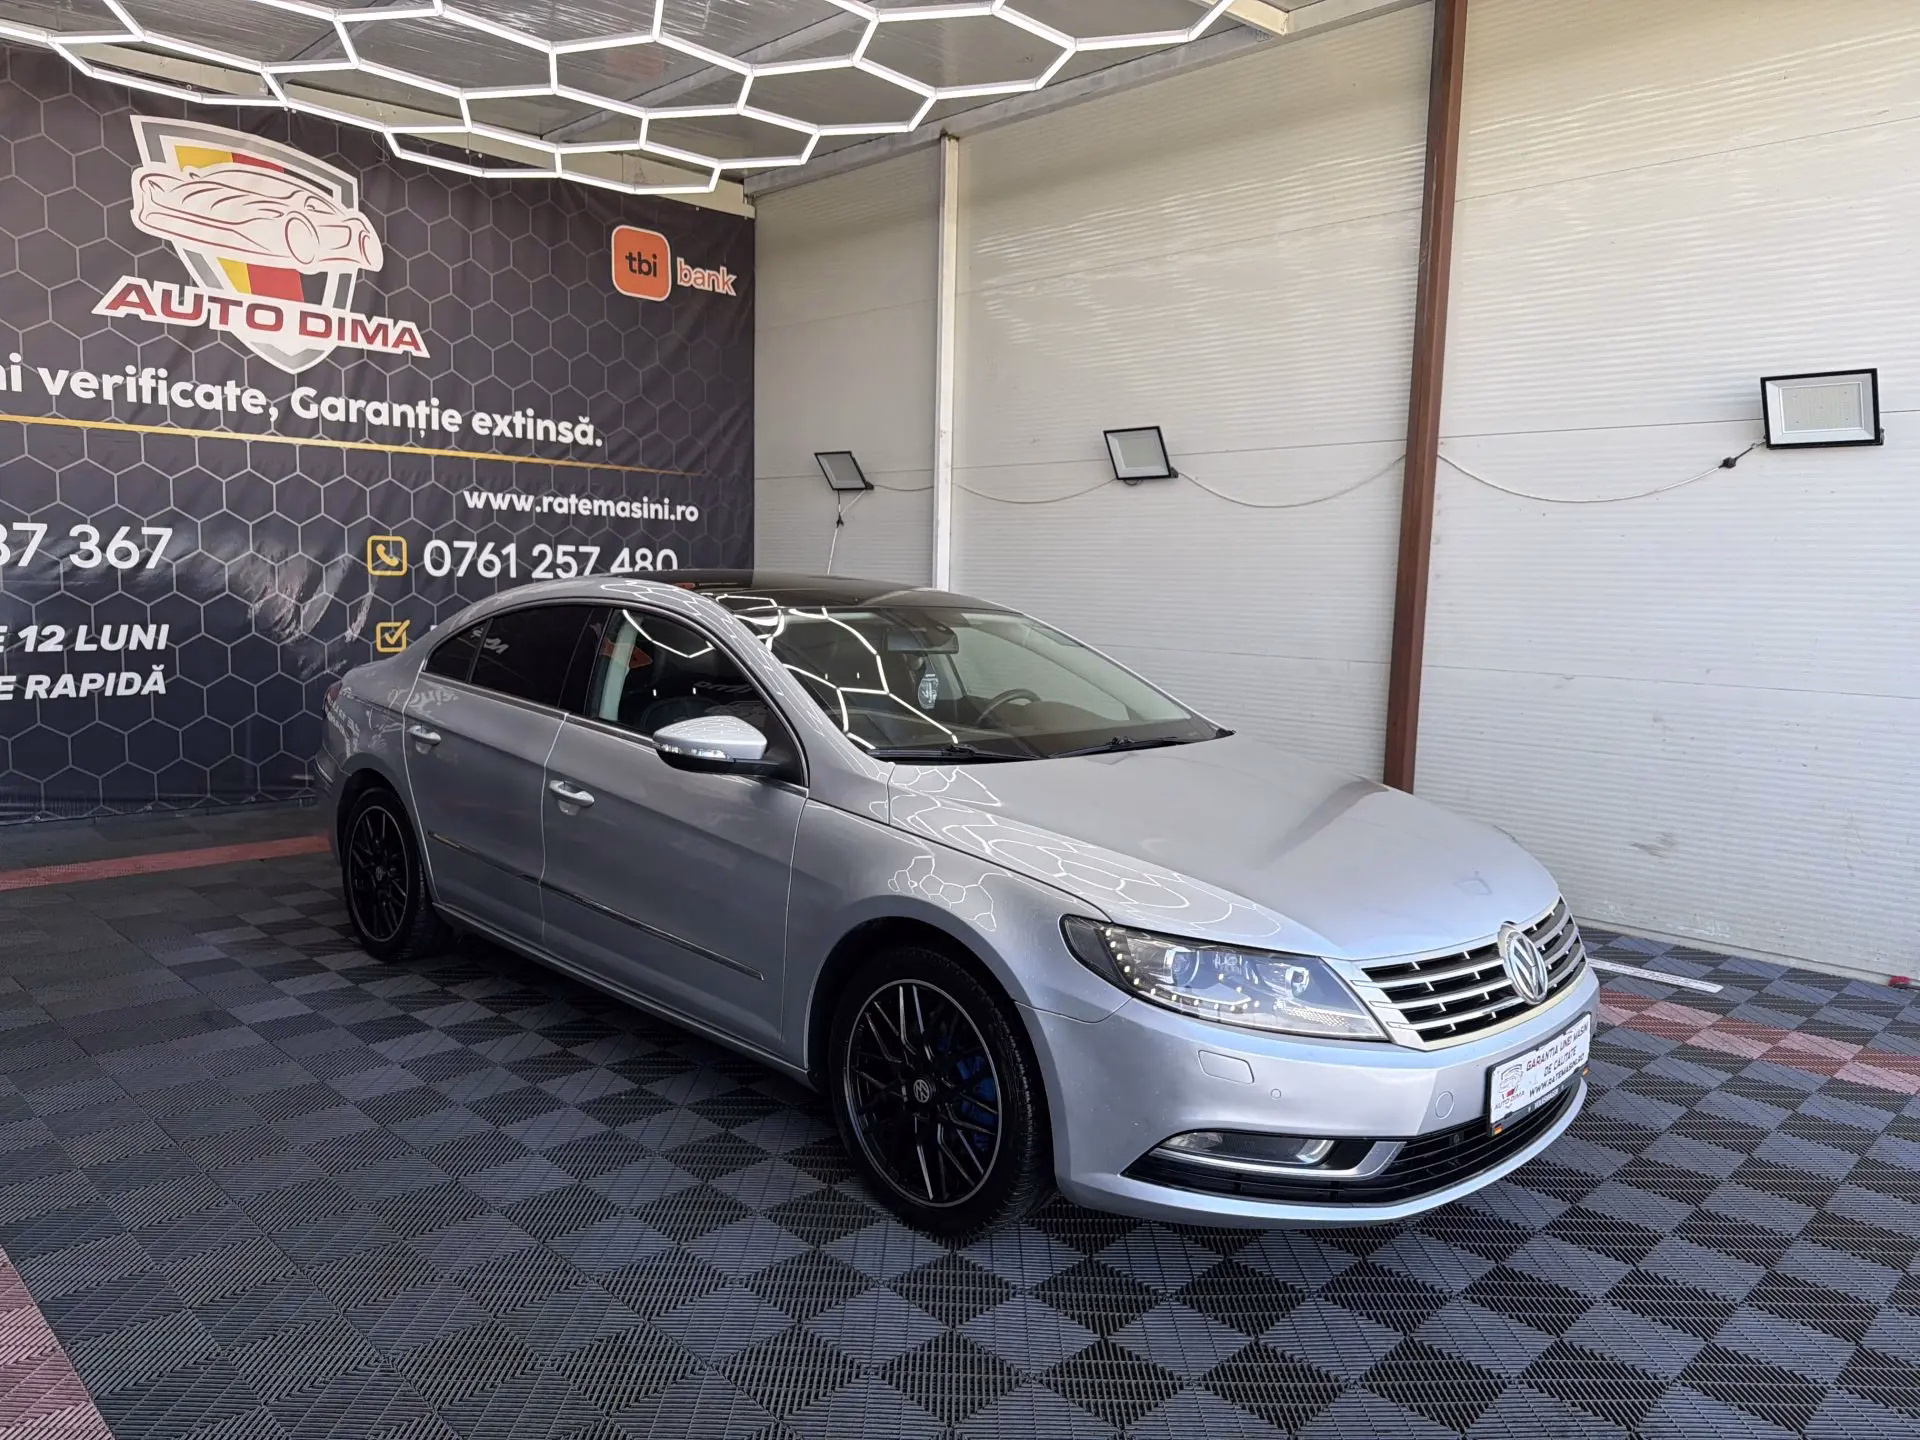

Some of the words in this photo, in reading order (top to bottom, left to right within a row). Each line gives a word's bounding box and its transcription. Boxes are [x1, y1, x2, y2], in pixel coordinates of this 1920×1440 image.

[624, 251, 658, 278] tbi
[677, 256, 738, 297] bank
[104, 282, 285, 333] AUTO
[298, 309, 423, 352] DIMA
[0, 352, 23, 393] i
[36, 364, 279, 422] verificate,
[290, 385, 463, 438] Garanție
[471, 407, 604, 448] extinsă.
[462, 489, 700, 523] www.ratemasini.ro
[68, 523, 174, 570] 367
[423, 538, 517, 579] 0761
[531, 543, 602, 579] 257
[609, 547, 679, 576] 480
[17, 624, 66, 653] 12
[74, 623, 170, 652] LUNI
[24, 663, 167, 700] RAPIDĂ
